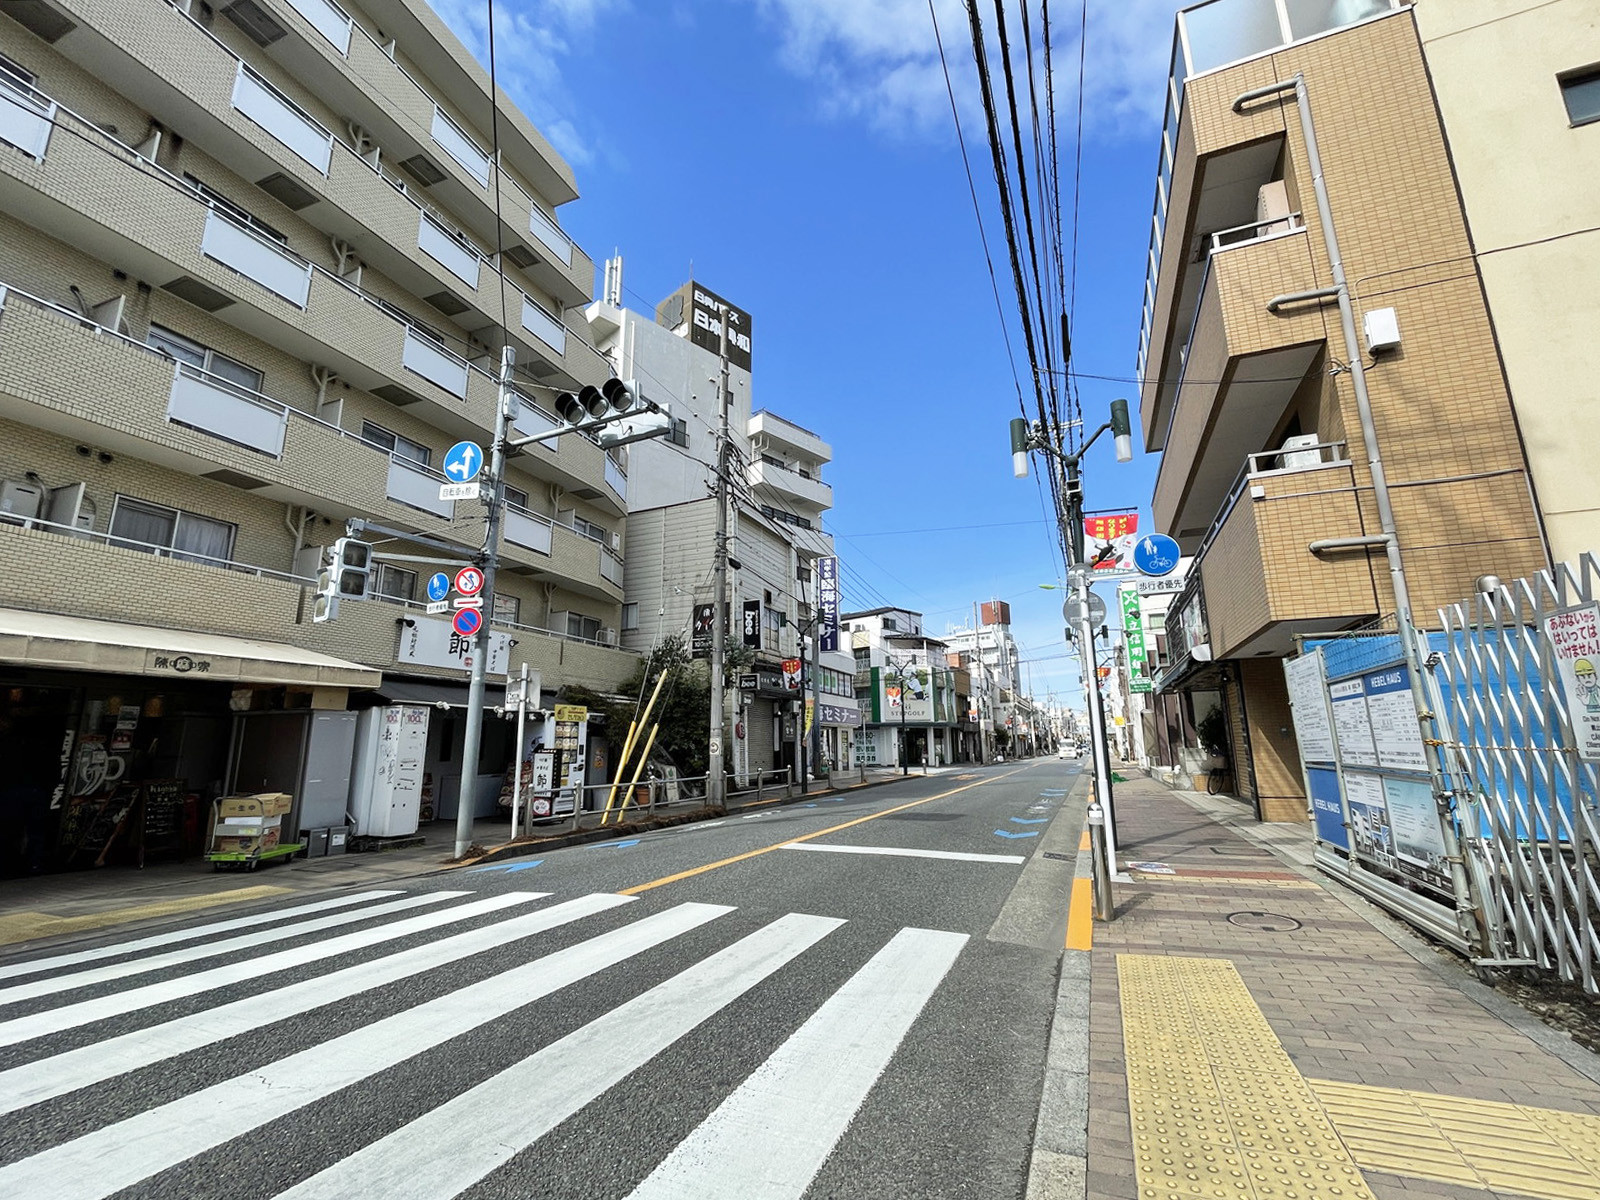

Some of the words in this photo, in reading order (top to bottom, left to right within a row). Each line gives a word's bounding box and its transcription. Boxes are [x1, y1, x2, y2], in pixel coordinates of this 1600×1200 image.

[1139, 579, 1183, 592] 歩行者優先
[1549, 611, 1596, 632] あぶないから
[1552, 624, 1598, 646] はいっては
[1370, 675, 1387, 688] HEBEL
[1387, 671, 1402, 685] HAUS
